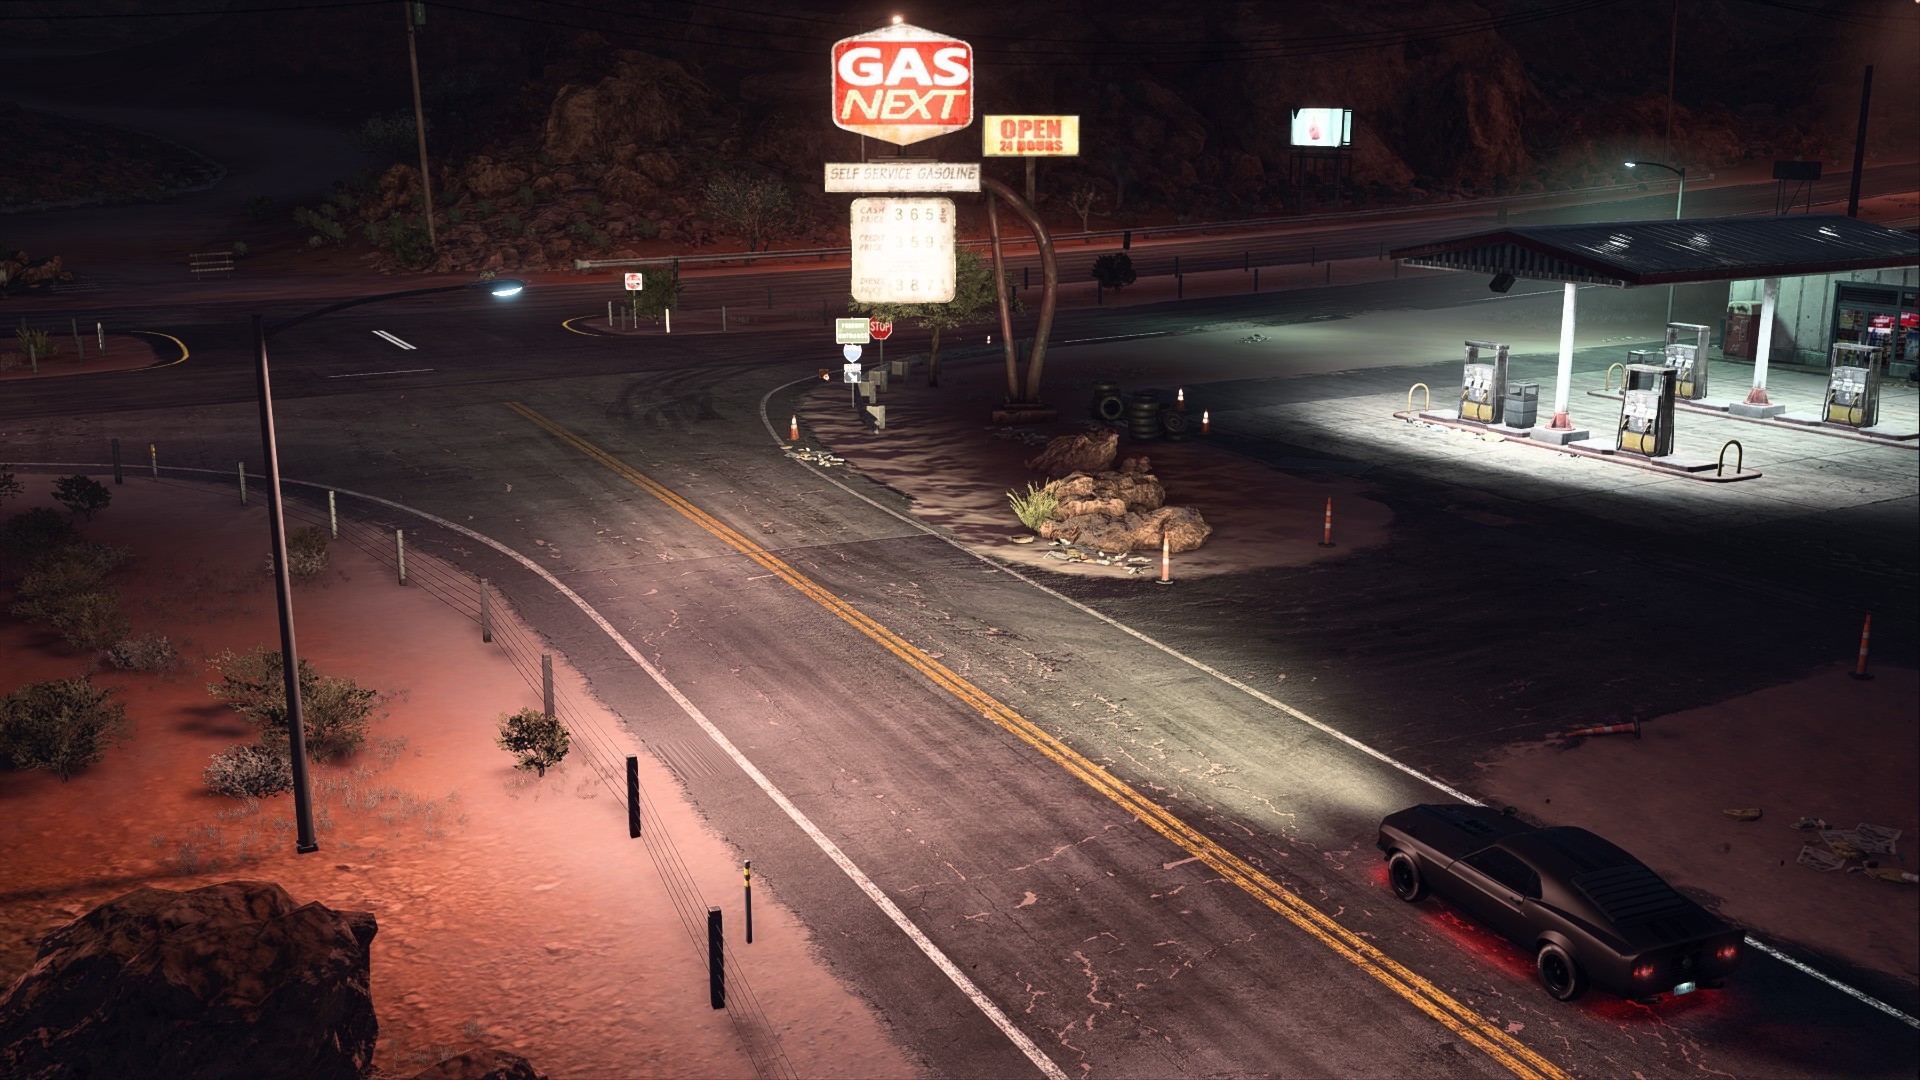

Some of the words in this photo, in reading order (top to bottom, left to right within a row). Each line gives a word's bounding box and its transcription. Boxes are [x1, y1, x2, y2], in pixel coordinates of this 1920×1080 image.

[838, 47, 969, 86] GAS
[841, 89, 966, 119] NEXT
[1000, 119, 1062, 139] OPEN
[1000, 140, 1013, 152] 24
[1017, 140, 1063, 152] HOURS
[830, 167, 860, 180] SELF
[864, 167, 912, 180] SERVICE
[917, 166, 977, 180] GASOLINE
[859, 206, 885, 214] CASH
[870, 321, 890, 332] STOP
